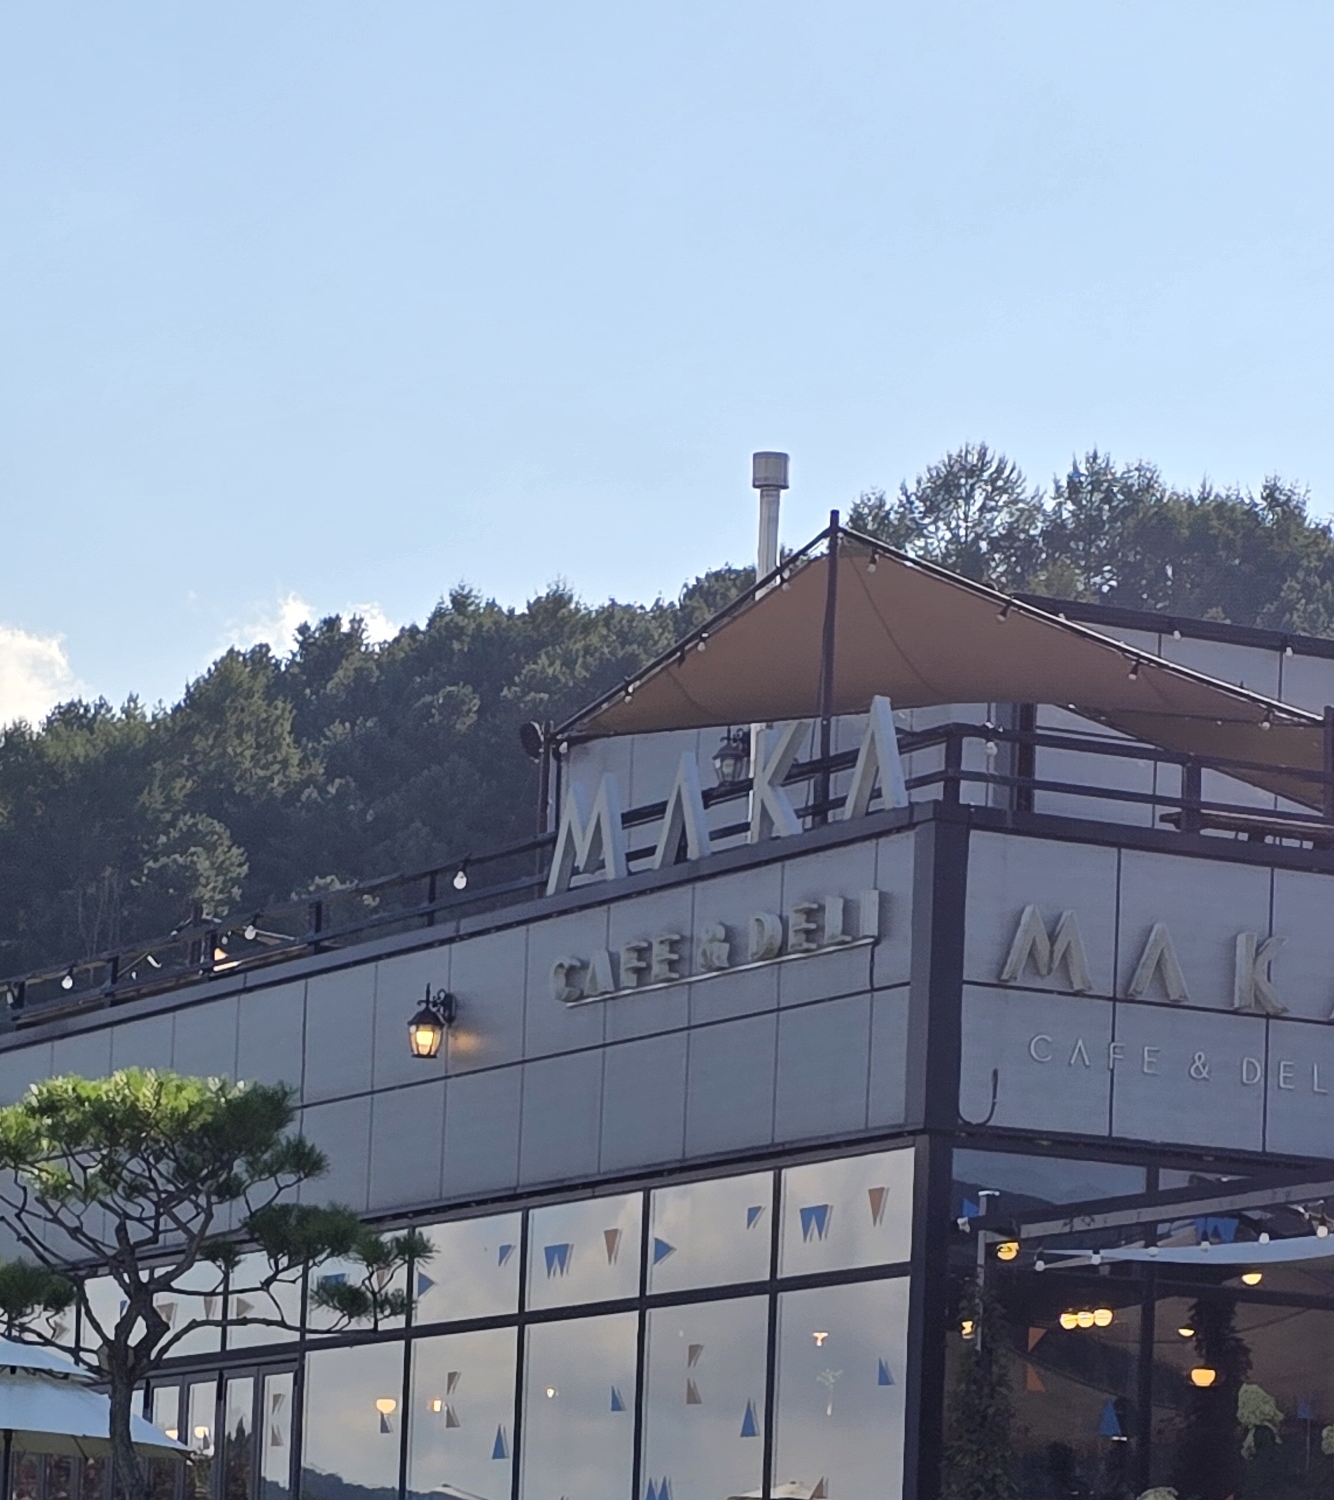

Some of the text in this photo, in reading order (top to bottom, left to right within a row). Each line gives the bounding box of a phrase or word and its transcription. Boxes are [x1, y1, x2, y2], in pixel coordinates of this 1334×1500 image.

[546, 695, 909, 896] MAKA
[550, 889, 880, 1001] CAFE & DELI
[1029, 1034, 1161, 1076] CAFE
[1188, 1051, 1213, 1082] &
